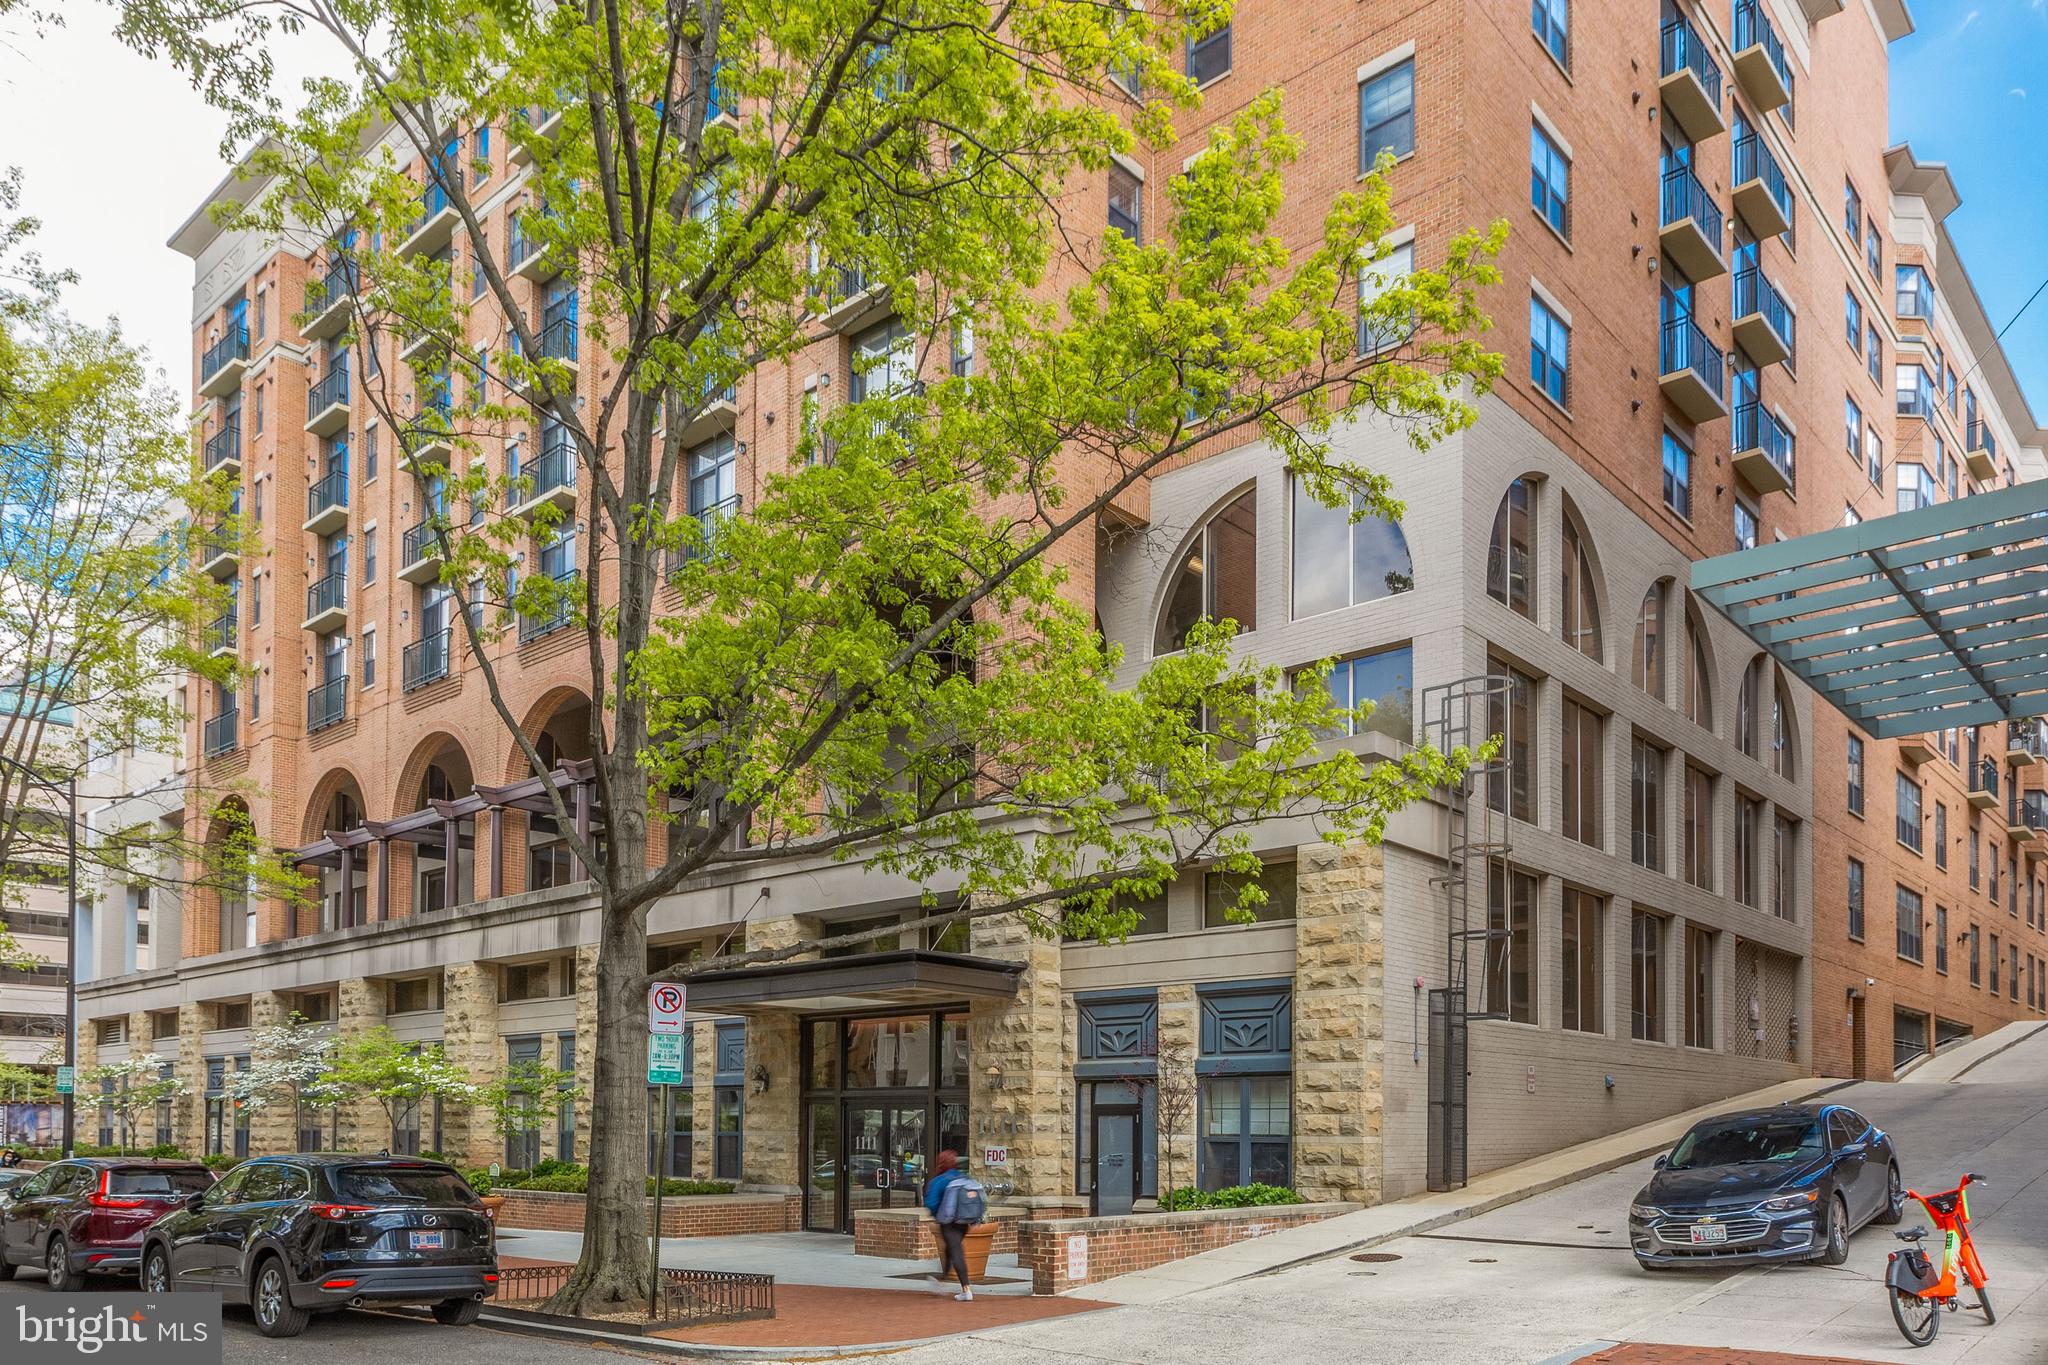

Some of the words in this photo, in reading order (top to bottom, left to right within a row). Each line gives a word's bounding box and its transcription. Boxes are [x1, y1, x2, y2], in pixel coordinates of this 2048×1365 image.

[855, 1136, 876, 1150] 1111
[986, 1149, 1005, 1162] FDC
[1074, 1240, 1082, 1249] NO
